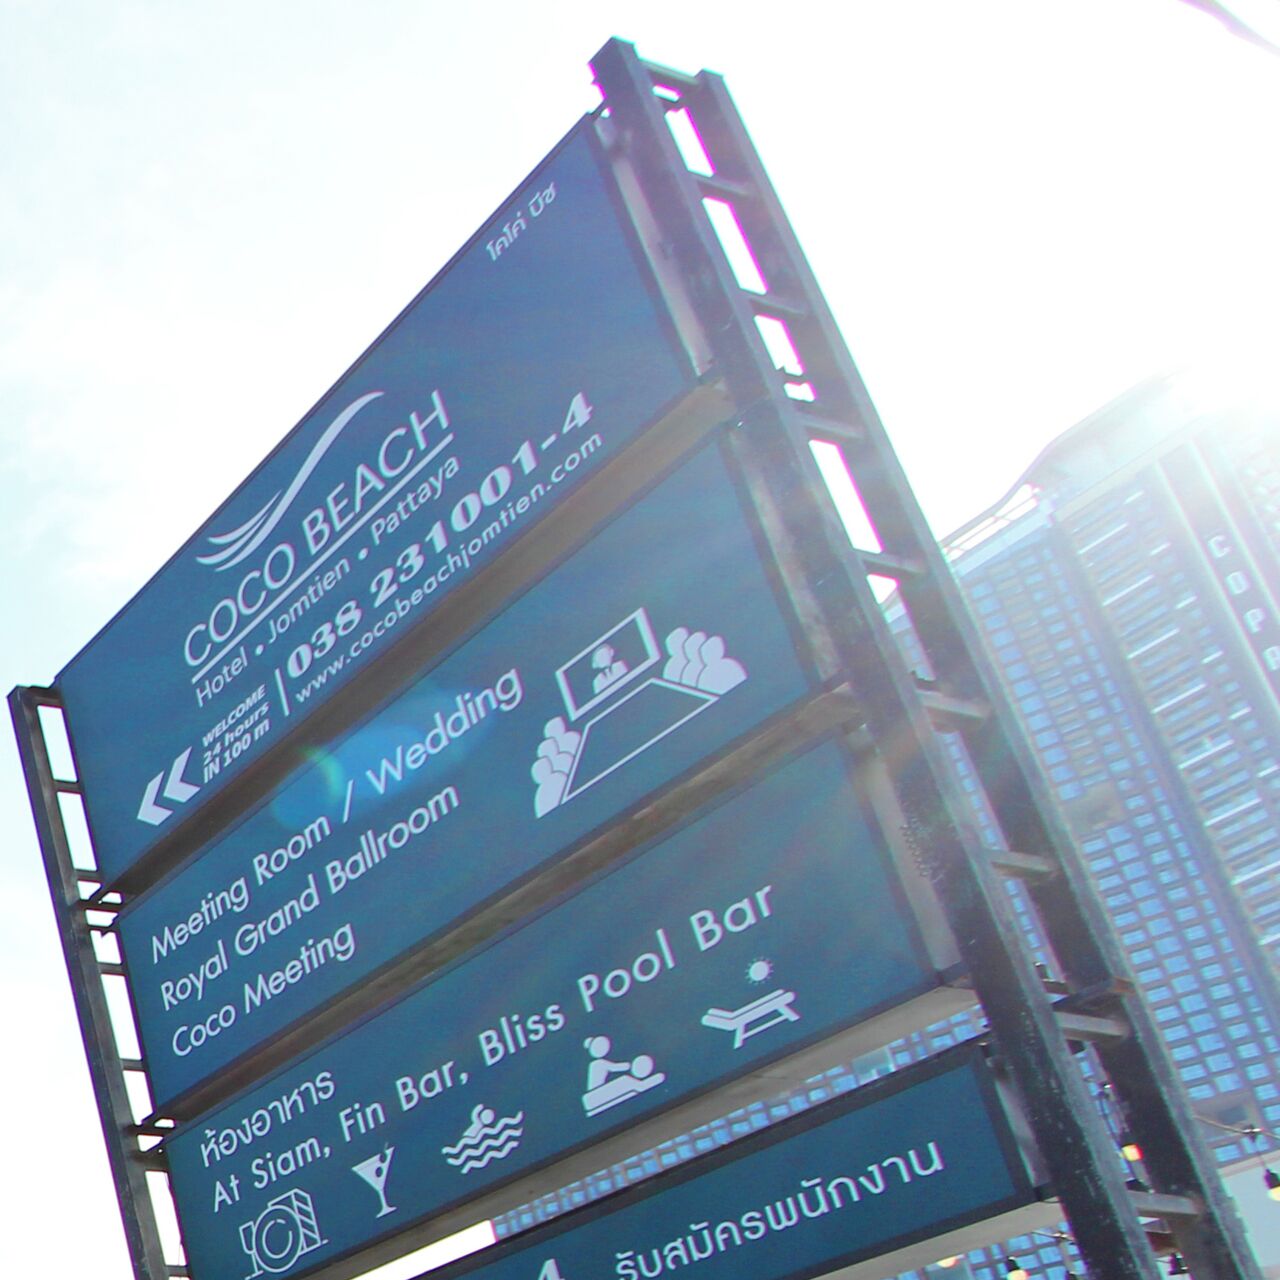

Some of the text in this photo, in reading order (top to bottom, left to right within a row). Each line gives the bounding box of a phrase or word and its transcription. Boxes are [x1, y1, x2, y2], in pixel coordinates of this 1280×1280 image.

[183, 389, 452, 669] COCO BEACH
[195, 454, 462, 709] Hotel Jomtien Pattaya
[286, 391, 595, 679] 038 231001-4
[295, 432, 604, 705] www.cocobeachjomtien.com
[151, 876, 250, 965] Meeting
[253, 814, 332, 887] Room
[366, 668, 524, 796] Wedding
[202, 683, 267, 748] WELCOME
[203, 701, 271, 767] 24 hours
[203, 718, 271, 784] IN 100 m
[160, 784, 460, 1012] Royal Grand Ballroom
[172, 922, 357, 1058] Coco Meeting
[200, 1069, 336, 1169] ห้องอาหาร
[212, 884, 776, 1214] At Siam, Fin Bar, Bliss Pool Bar
